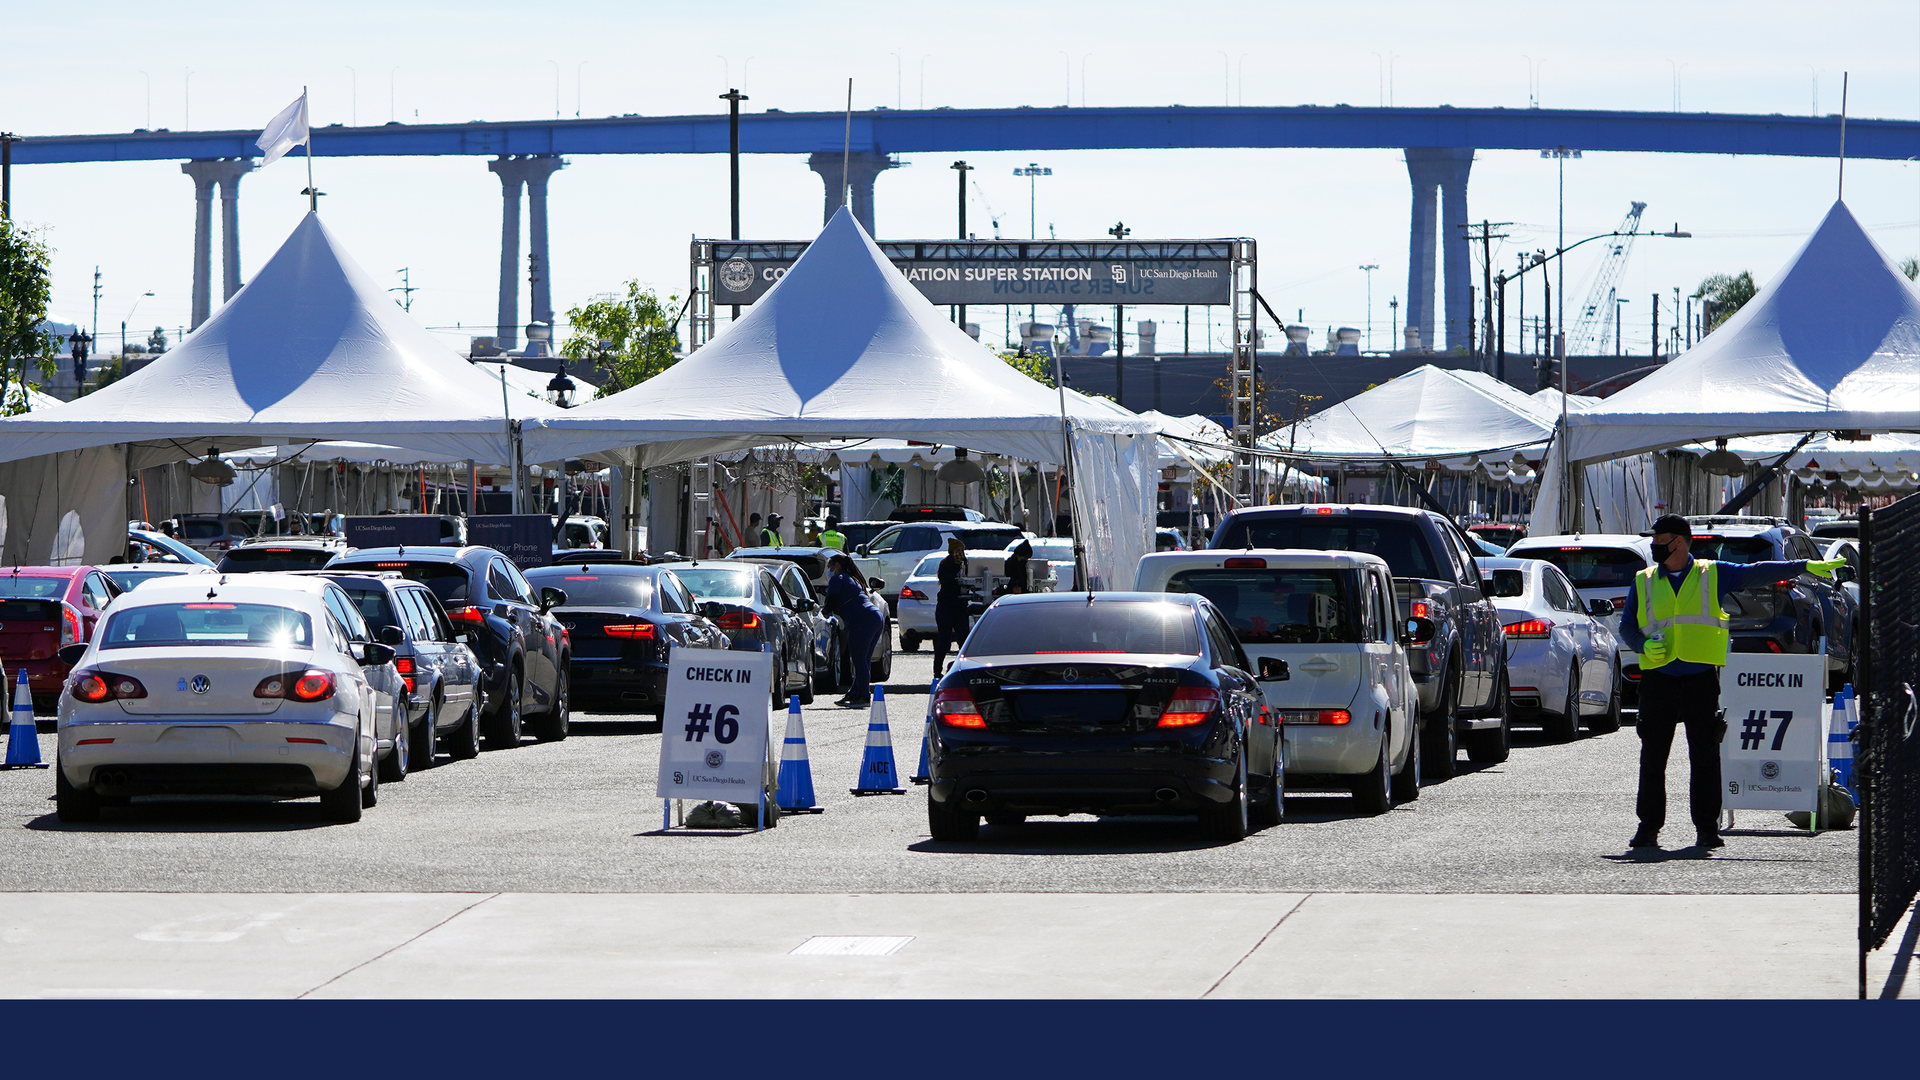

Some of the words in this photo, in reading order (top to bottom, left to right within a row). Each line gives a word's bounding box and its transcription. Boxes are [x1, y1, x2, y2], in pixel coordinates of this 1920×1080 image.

[762, 267, 790, 281] CO
[964, 267, 1018, 281] SUPER
[1022, 267, 1092, 281] STATION
[1140, 269, 1153, 278] UC
[1153, 269, 1168, 278] San
[1169, 269, 1191, 280] Diego
[1192, 268, 1218, 278] Health
[494, 544, 511, 552] Your
[513, 543, 538, 552] Phone
[686, 666, 734, 683] CHECK
[736, 669, 751, 684] IN
[1737, 672, 1785, 687] CHECK
[1788, 673, 1803, 688] IN
[684, 703, 740, 745] #6
[1740, 710, 1793, 751] #7
[869, 761, 890, 774] ACE
[702, 775, 712, 783] San
[712, 776, 728, 784] Diego
[728, 777, 746, 785] Health
[1768, 785, 1783, 793] Diego
